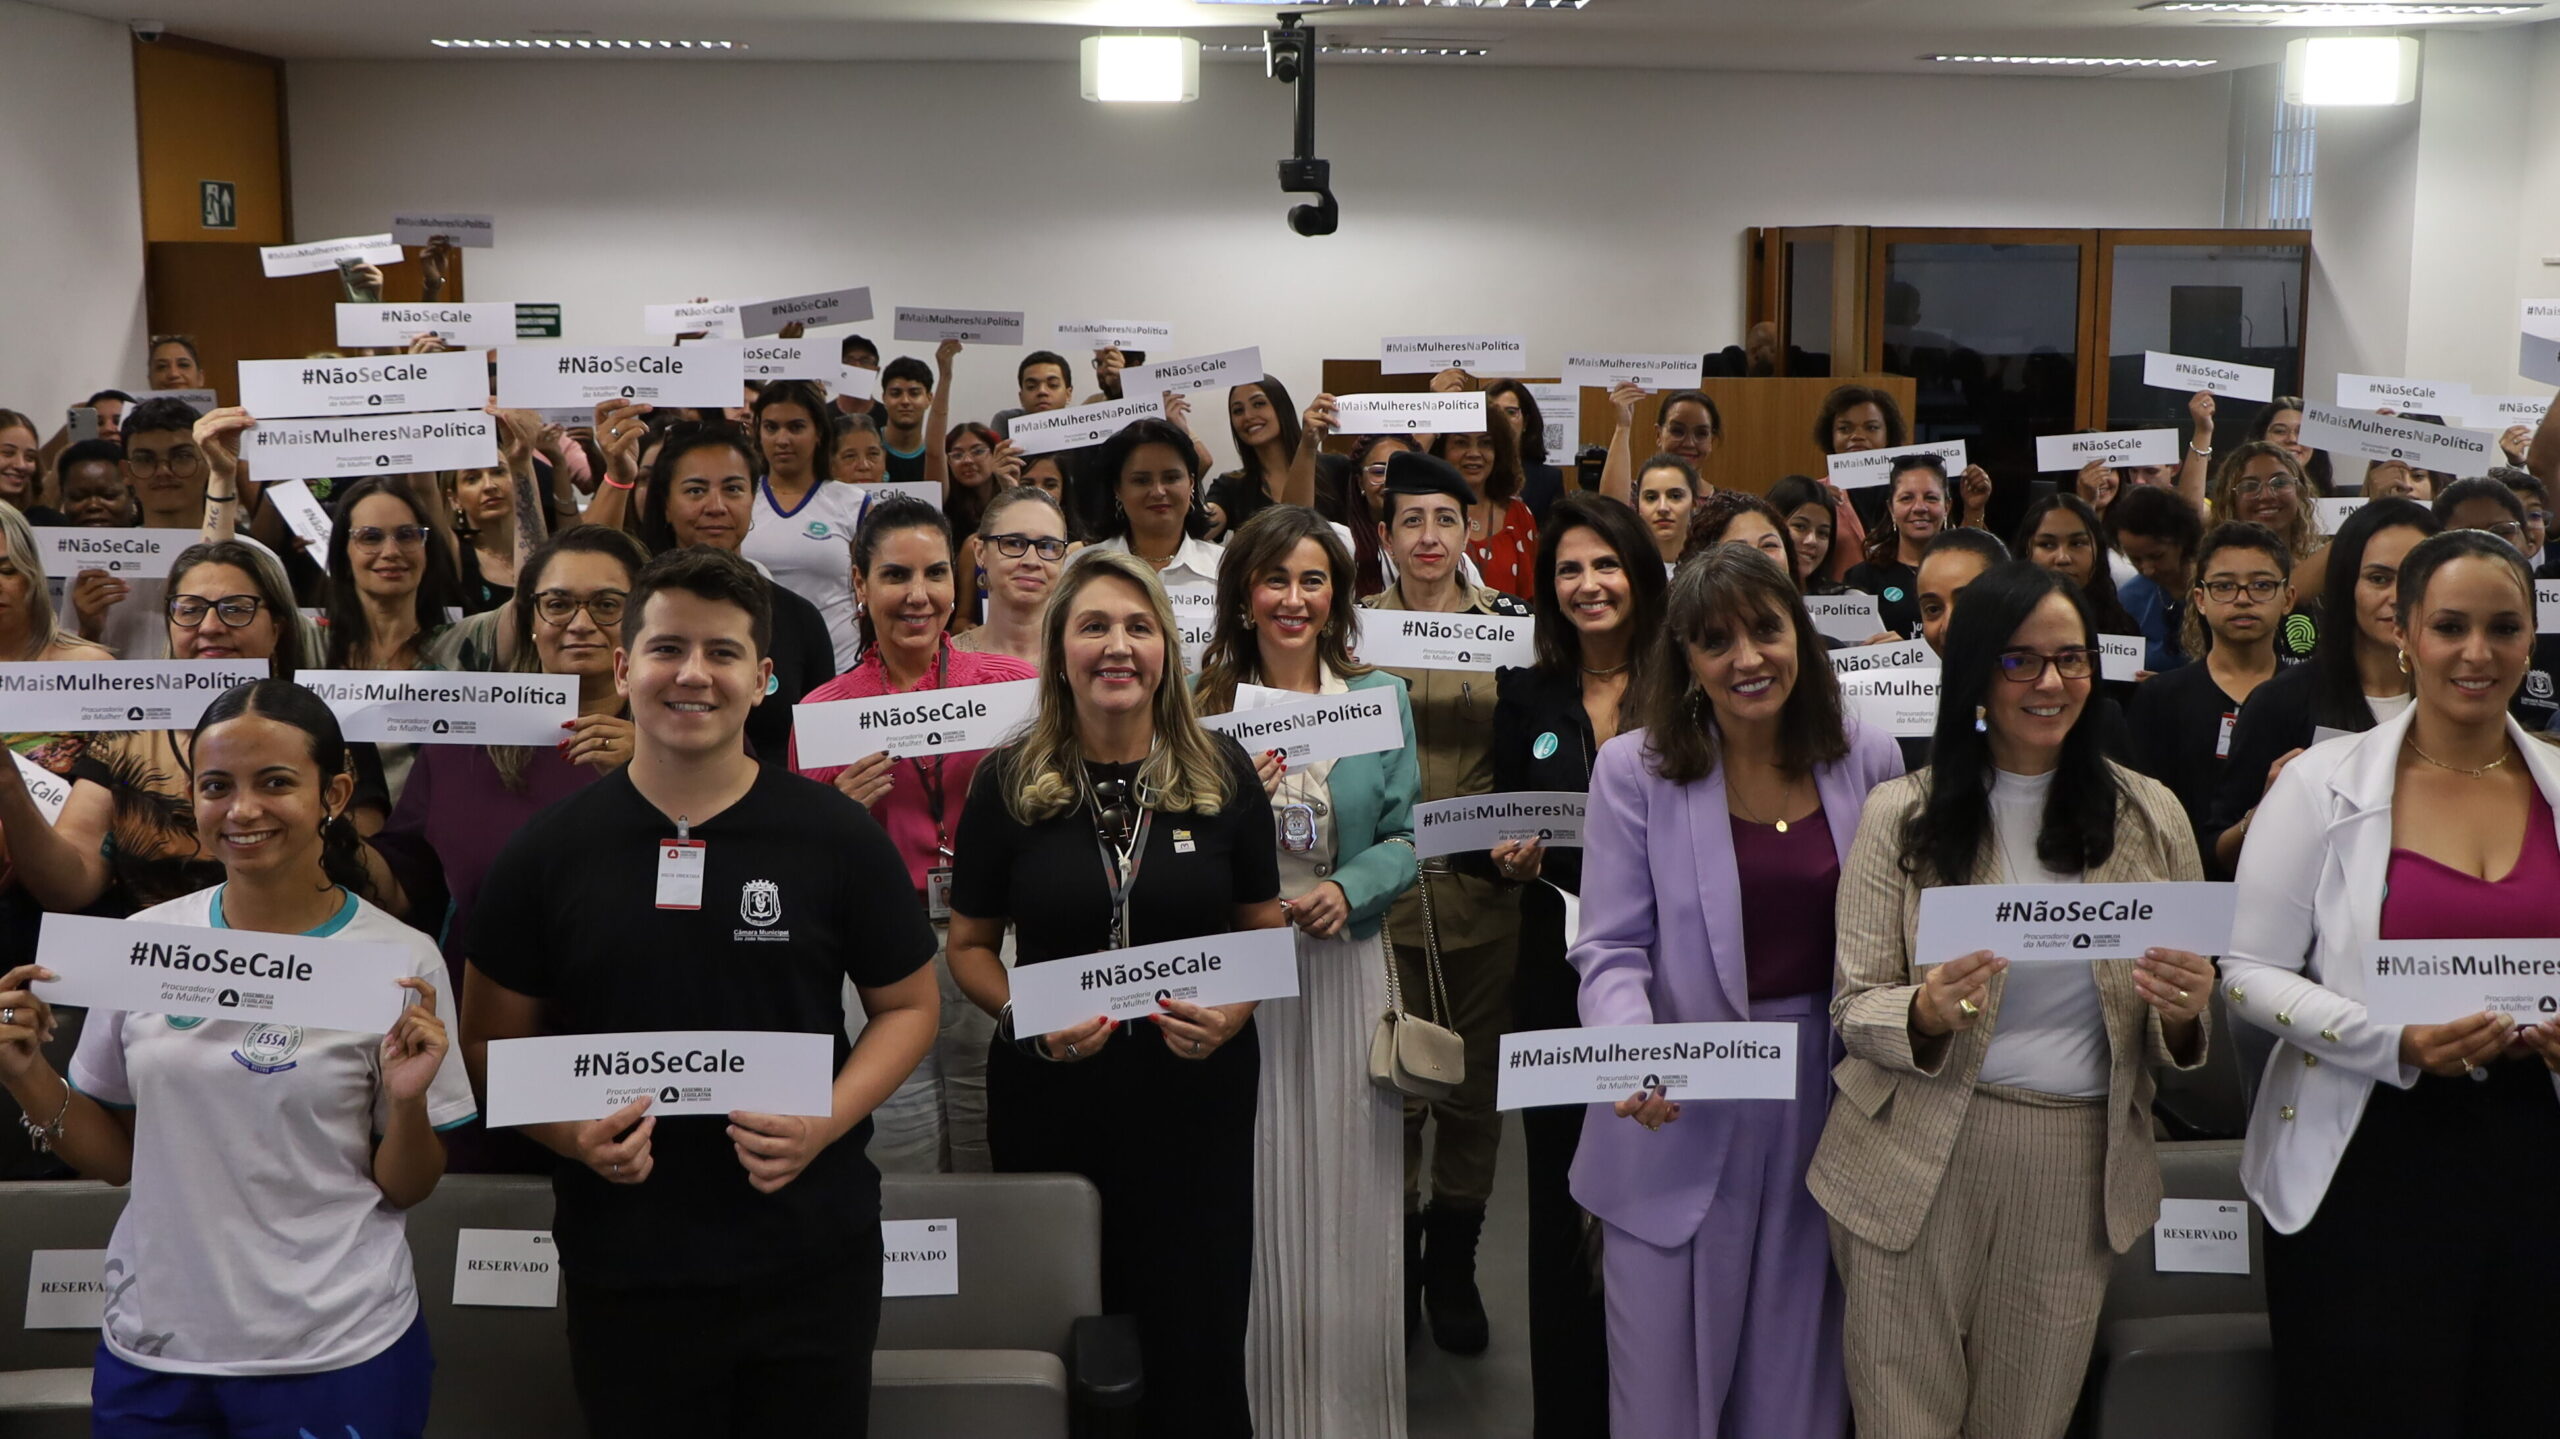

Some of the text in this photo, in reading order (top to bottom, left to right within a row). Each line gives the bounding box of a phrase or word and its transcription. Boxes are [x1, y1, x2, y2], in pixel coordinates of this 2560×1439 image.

[674, 304, 735, 317] #NãoSeCale
[772, 297, 839, 316] #NãoSeCale
[381, 309, 472, 323] #NãoSeCale
[899, 313, 1020, 327] #MaisMulheresNaPolítica
[1058, 324, 1168, 336] #MaisMulheresNaPolítica
[743, 347, 801, 360] oSeCale
[1386, 340, 1520, 353] #MaisMulheresNaPolítica
[558, 355, 683, 374] #NãoSeCale
[1155, 359, 1227, 379] #NãoSeCale
[1568, 357, 1698, 371] #MaisMulheresNaPolítica
[302, 363, 428, 385] #NãoSeCale
[2175, 363, 2240, 382] #NãoSeCale
[2369, 383, 2436, 398] #NãoSeCale
[2498, 402, 2547, 414] #NãoSe
[1014, 402, 1159, 434] #MaisMulheresNaPolítica
[257, 422, 487, 446] #MaisMulheresNaPolítica
[2309, 409, 2484, 452] #MaisMulheresNaPolítica
[2072, 438, 2142, 452] #NãoSeCale
[58, 538, 161, 554] #NãoSeCale
[1402, 620, 1515, 642] #NãoSeCale
[1832, 648, 1924, 673] NãoSeCale
[859, 699, 987, 730] #NãoSeCale
[1217, 703, 1382, 739] ulheresNaPolítica
[1423, 803, 1585, 827] #MaisMulheresNa
[1995, 899, 2153, 923] #NãoSeCale
[130, 941, 313, 981] #NãoSeCale
[2376, 954, 2560, 976] #MaisMulhere
[1080, 952, 1222, 991] #NãoSeCale
[161, 982, 215, 994] Procuradoria
[161, 990, 211, 1003] da Mulher
[1110, 990, 1151, 1002] Procuradoria
[1112, 999, 1149, 1010] da Mulher
[257, 1032, 287, 1047] ESSA
[1510, 1039, 1781, 1068] #MaisMulheresNaPolítica
[574, 1049, 745, 1077] #NãoSeCale
[606, 1086, 656, 1096] Procuradoria
[606, 1095, 618, 1105] da
[2163, 1228, 2238, 1241] RESERVADO
[883, 1250, 947, 1262] SERVADO
[467, 1259, 549, 1273] RESERVADO
[41, 1281, 106, 1293] RESERVA
